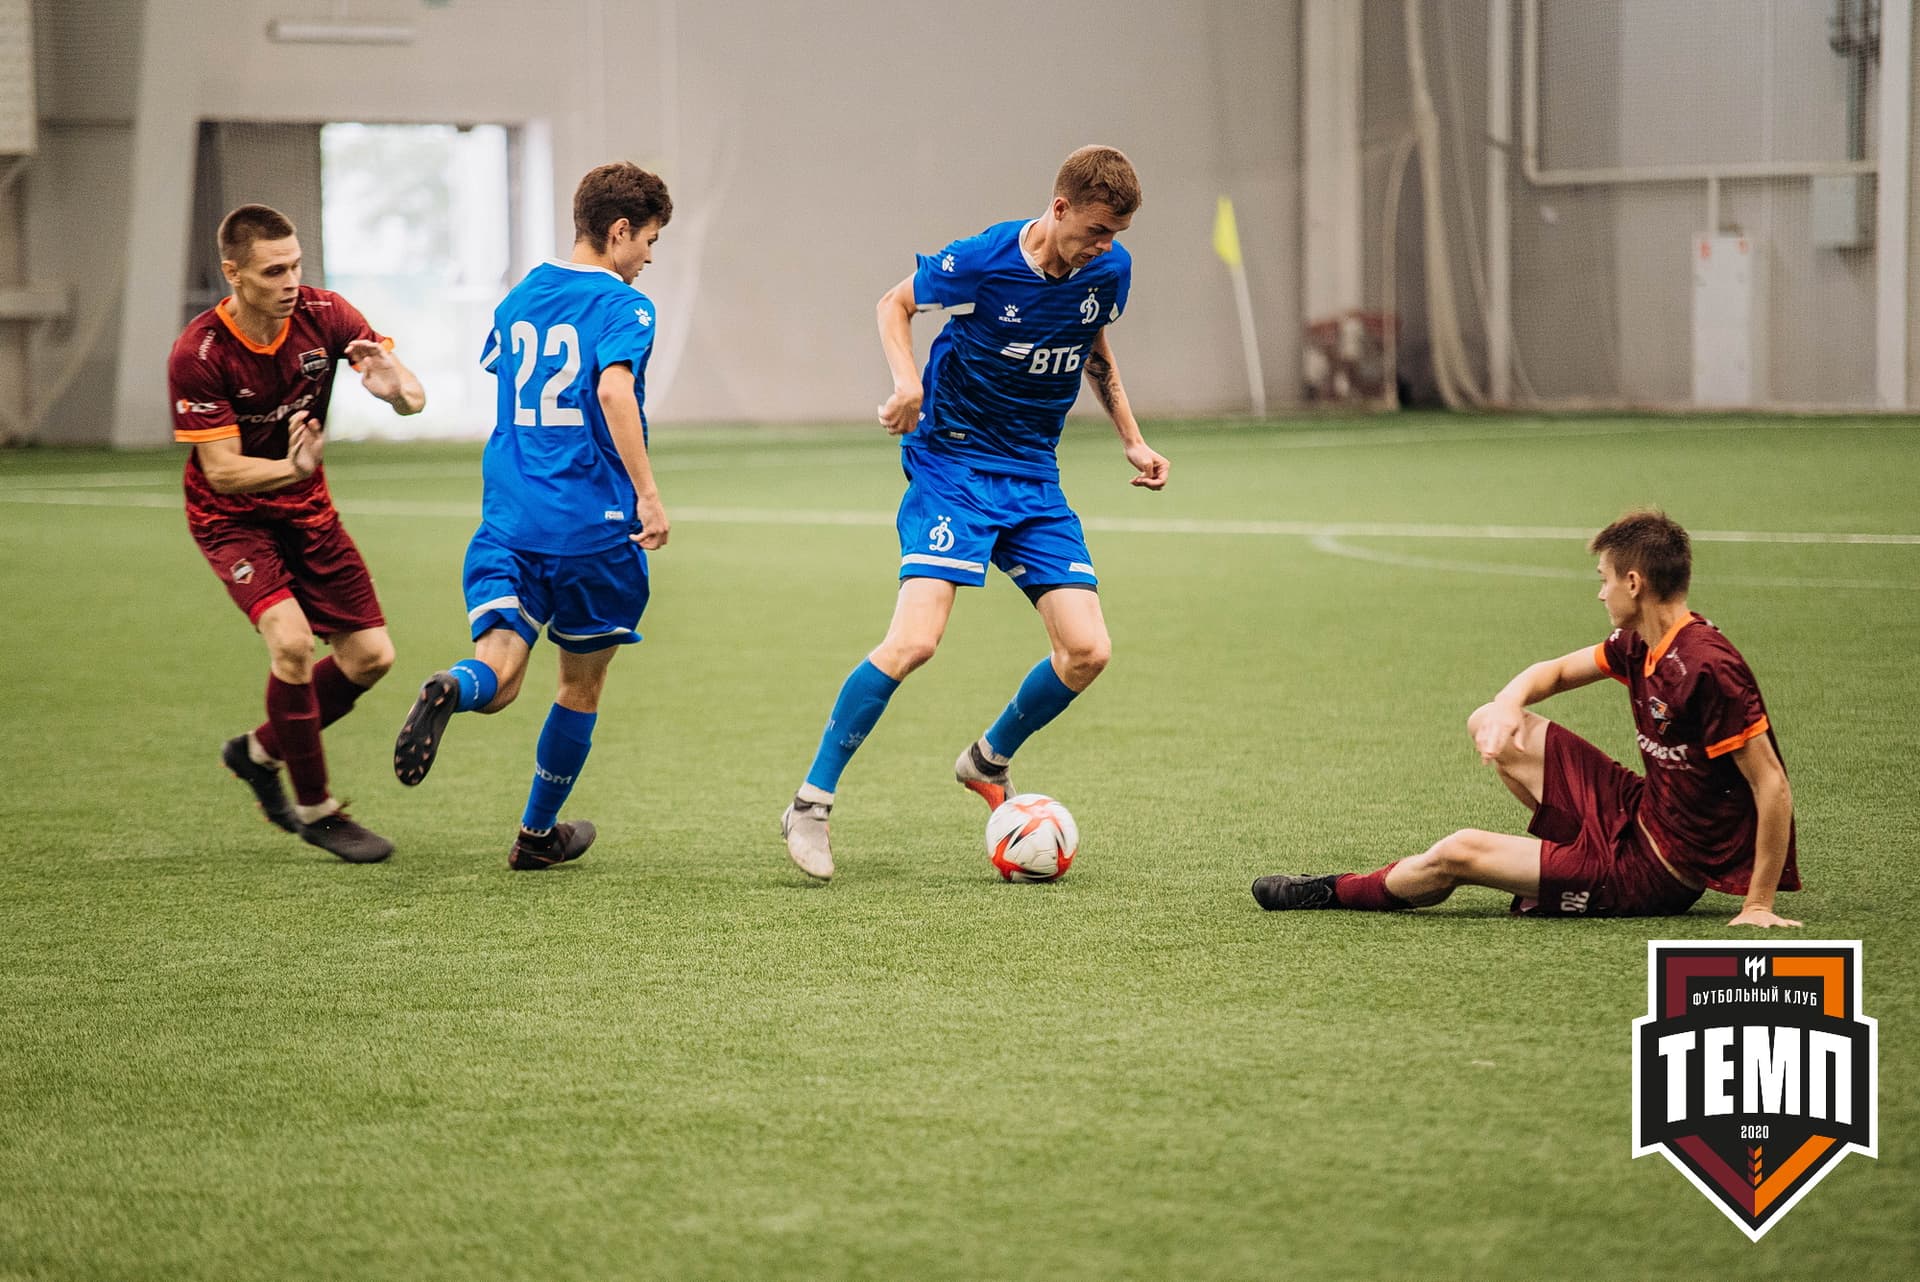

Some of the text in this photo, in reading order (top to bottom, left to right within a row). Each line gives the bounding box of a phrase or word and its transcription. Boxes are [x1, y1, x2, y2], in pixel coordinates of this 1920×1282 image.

[998, 315, 1022, 323] KELME
[510, 320, 584, 427] 22
[1028, 343, 1084, 374] ВТБ
